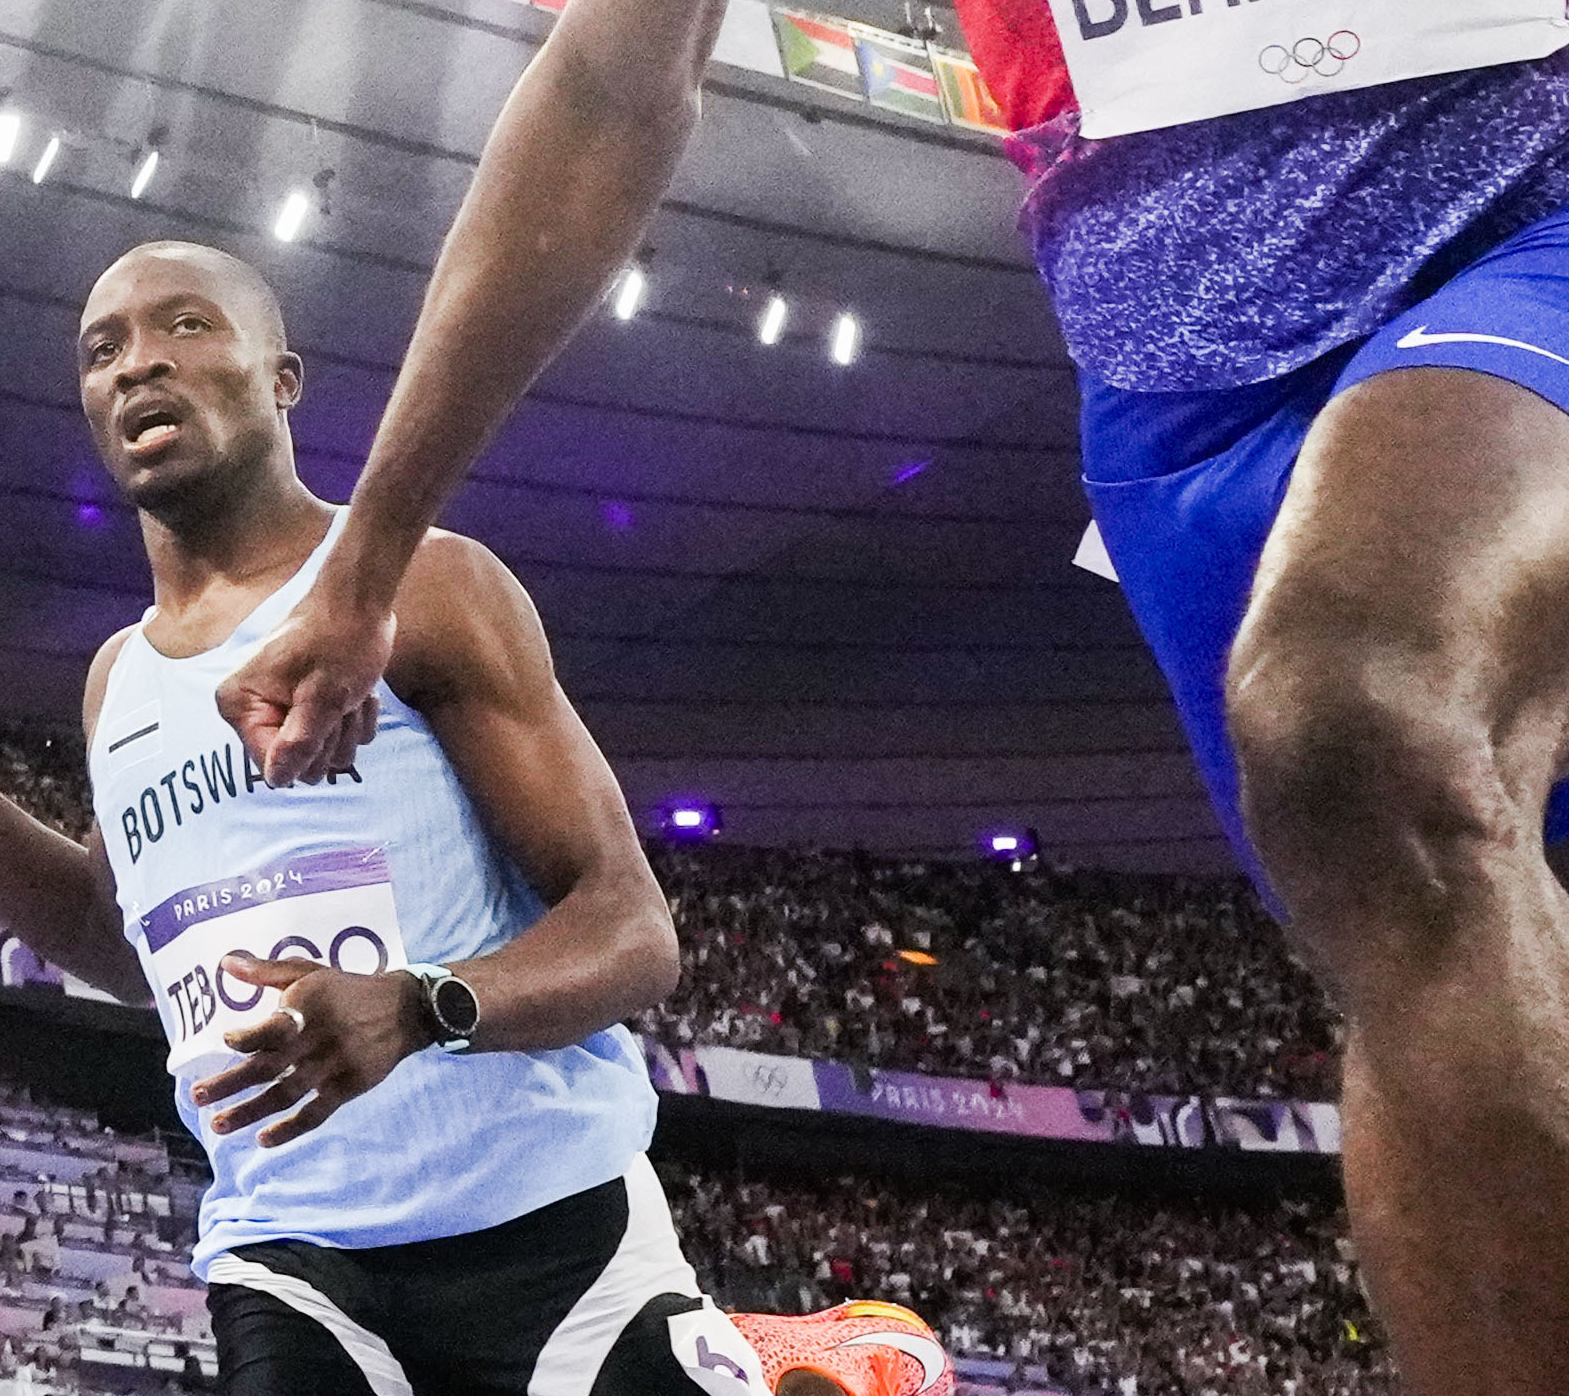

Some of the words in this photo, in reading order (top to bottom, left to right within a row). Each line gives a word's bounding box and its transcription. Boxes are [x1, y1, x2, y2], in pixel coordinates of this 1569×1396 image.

[121, 742, 363, 865] BOTSWA
[174, 886, 233, 922] PARIS
[240, 869, 304, 900] 2024
